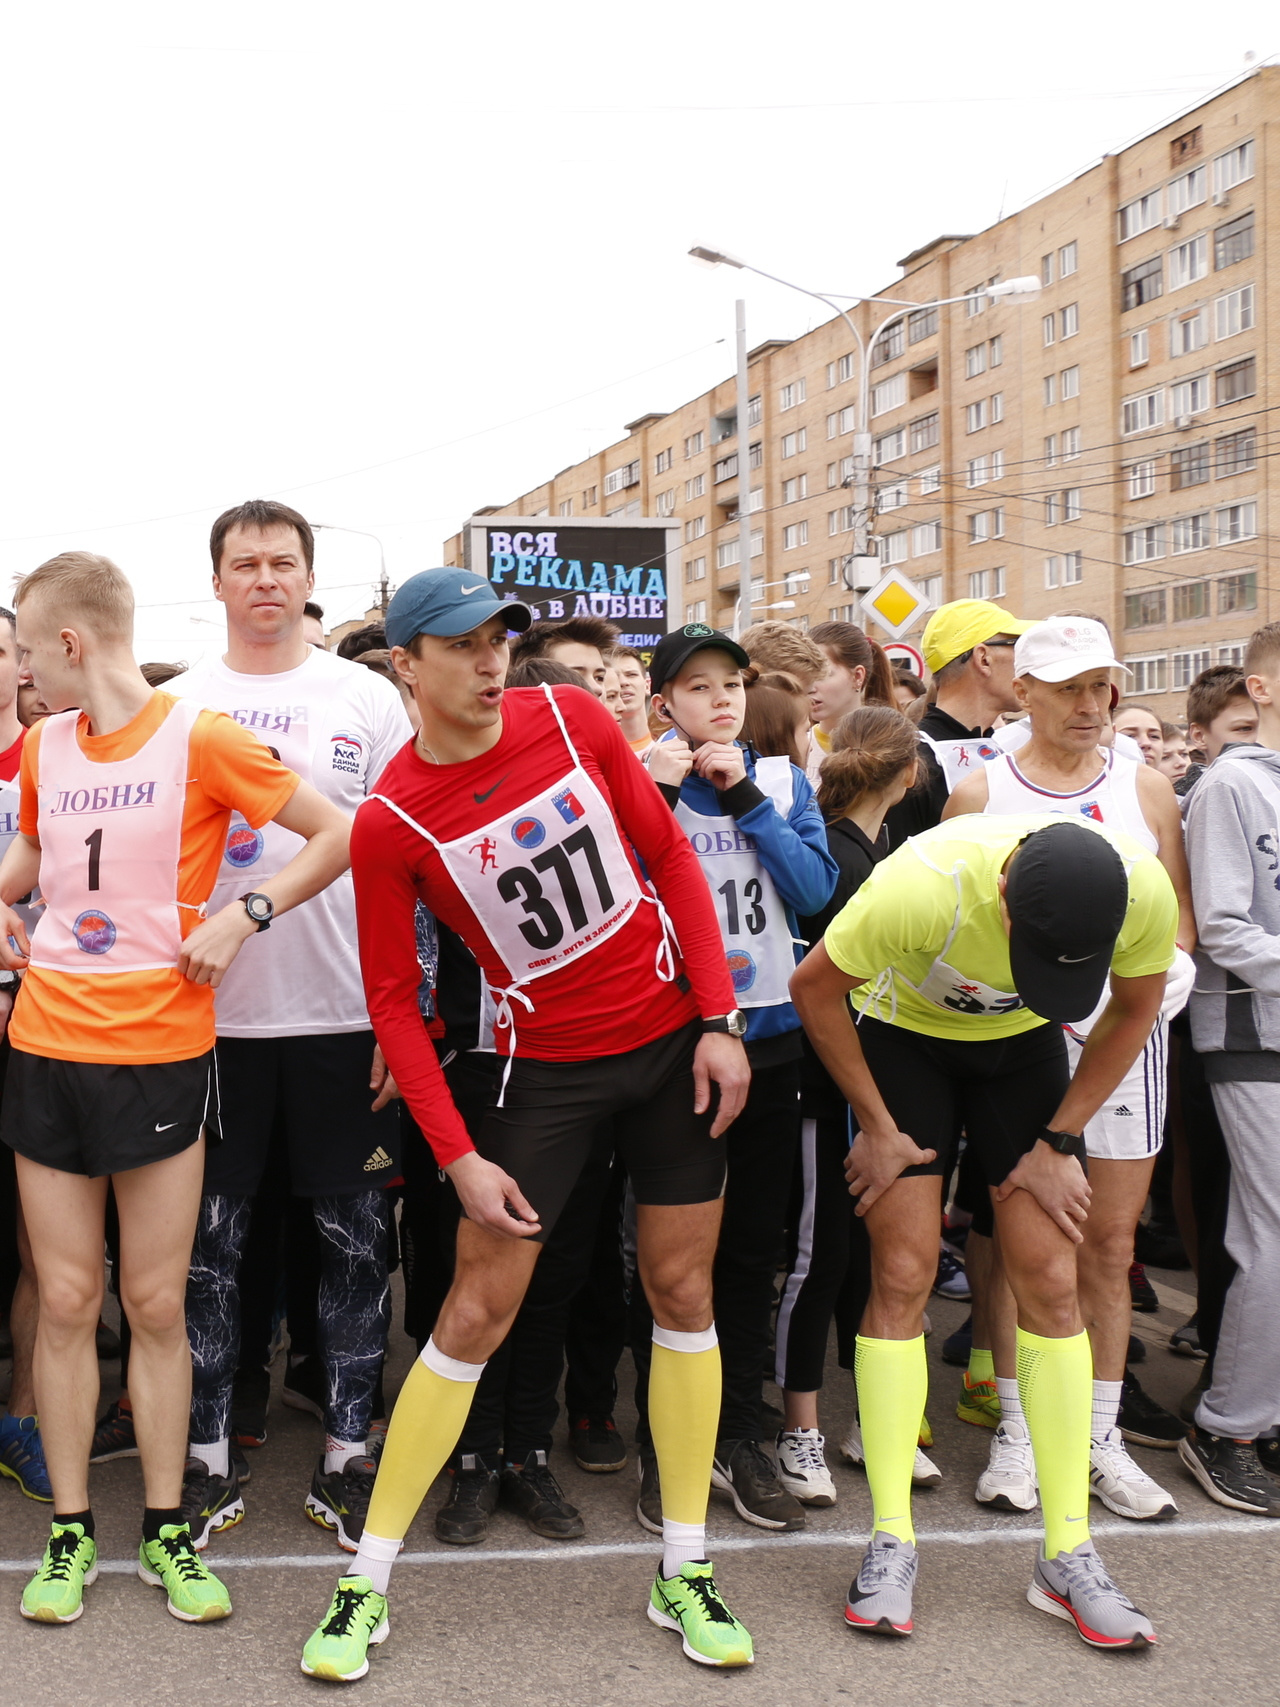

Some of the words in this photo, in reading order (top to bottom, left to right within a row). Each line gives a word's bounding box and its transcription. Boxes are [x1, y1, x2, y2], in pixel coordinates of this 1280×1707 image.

[490, 532, 558, 557] ВСЯ
[491, 552, 667, 599] РЕКЛАМА
[572, 593, 664, 618] ЛОБНЕ
[332, 758, 360, 769] ЕДИНАЯ
[332, 764, 359, 775] РОССИЯ
[51, 781, 158, 815] ЛОБНЯ
[85, 828, 103, 891] 1
[496, 825, 616, 950] 377
[717, 878, 766, 936] 13
[528, 954, 558, 969] СПОРТ
[562, 939, 585, 957] ПУТЬ
[363, 1157, 393, 1172] adidas
